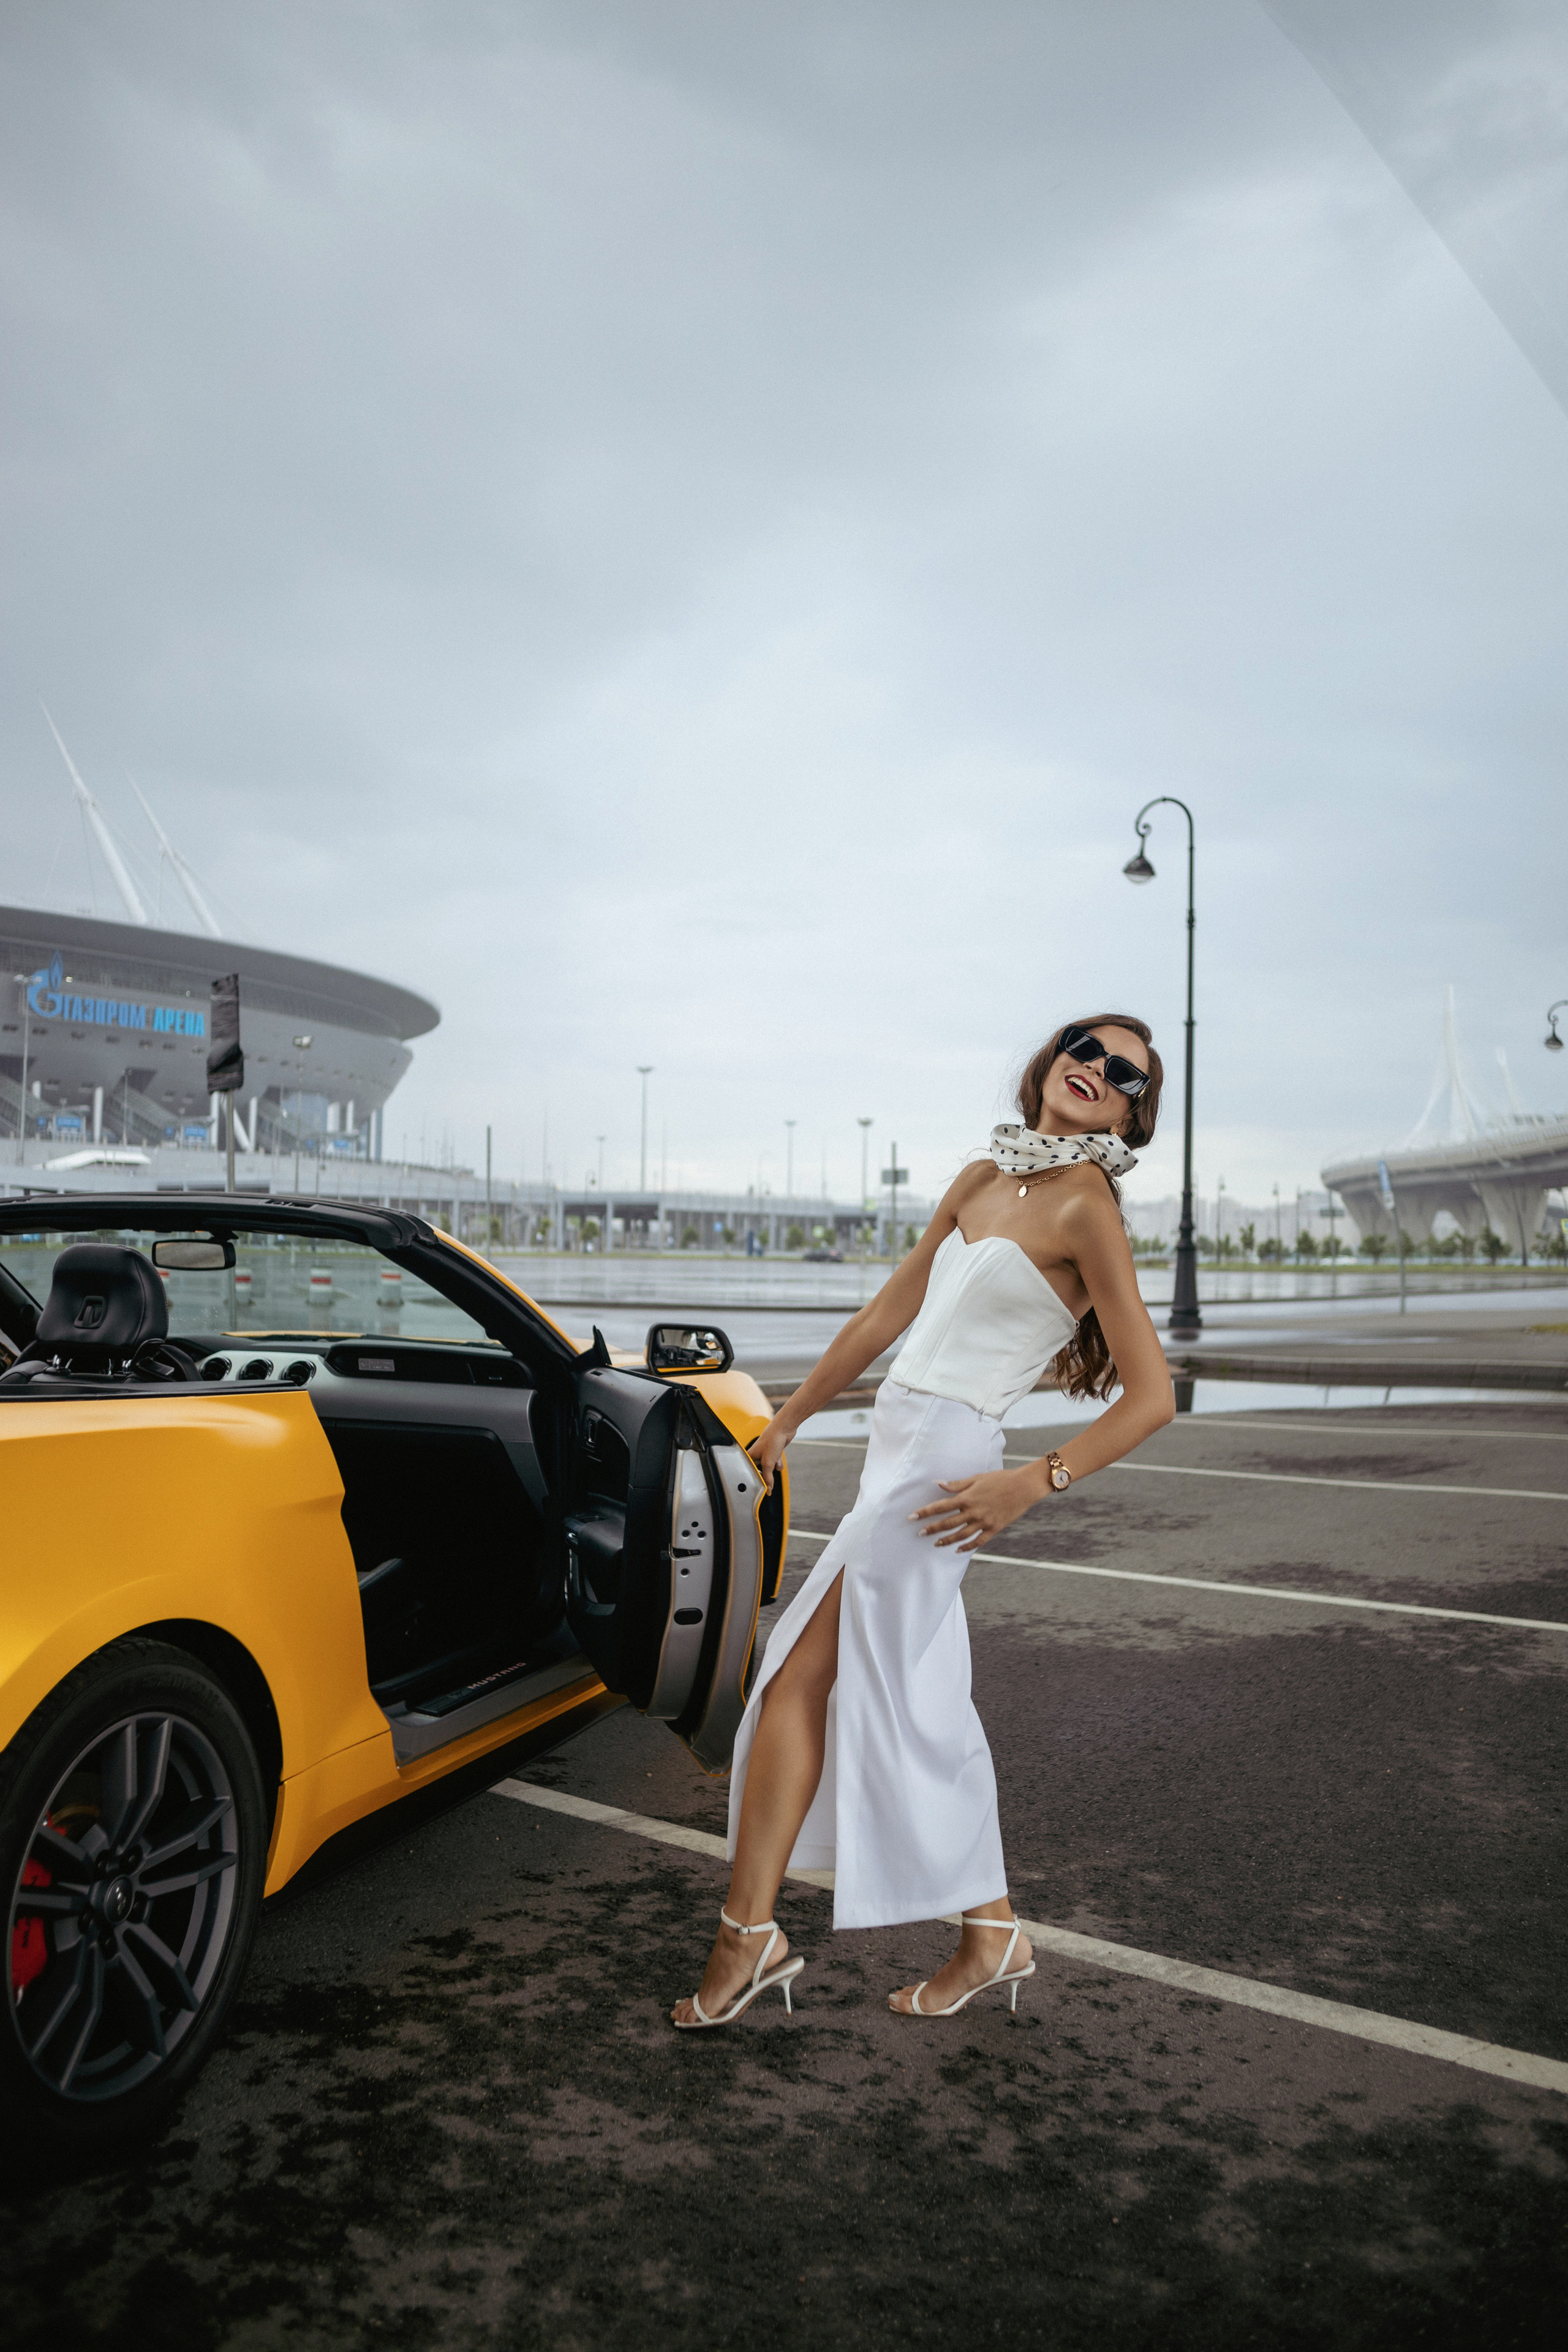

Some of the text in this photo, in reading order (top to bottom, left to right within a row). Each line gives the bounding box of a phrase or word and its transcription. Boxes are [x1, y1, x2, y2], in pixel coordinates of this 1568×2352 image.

[63, 995, 205, 1037] ГАЗПРОМ АРЕНА
[467, 1662, 526, 1689] MUSTANG
